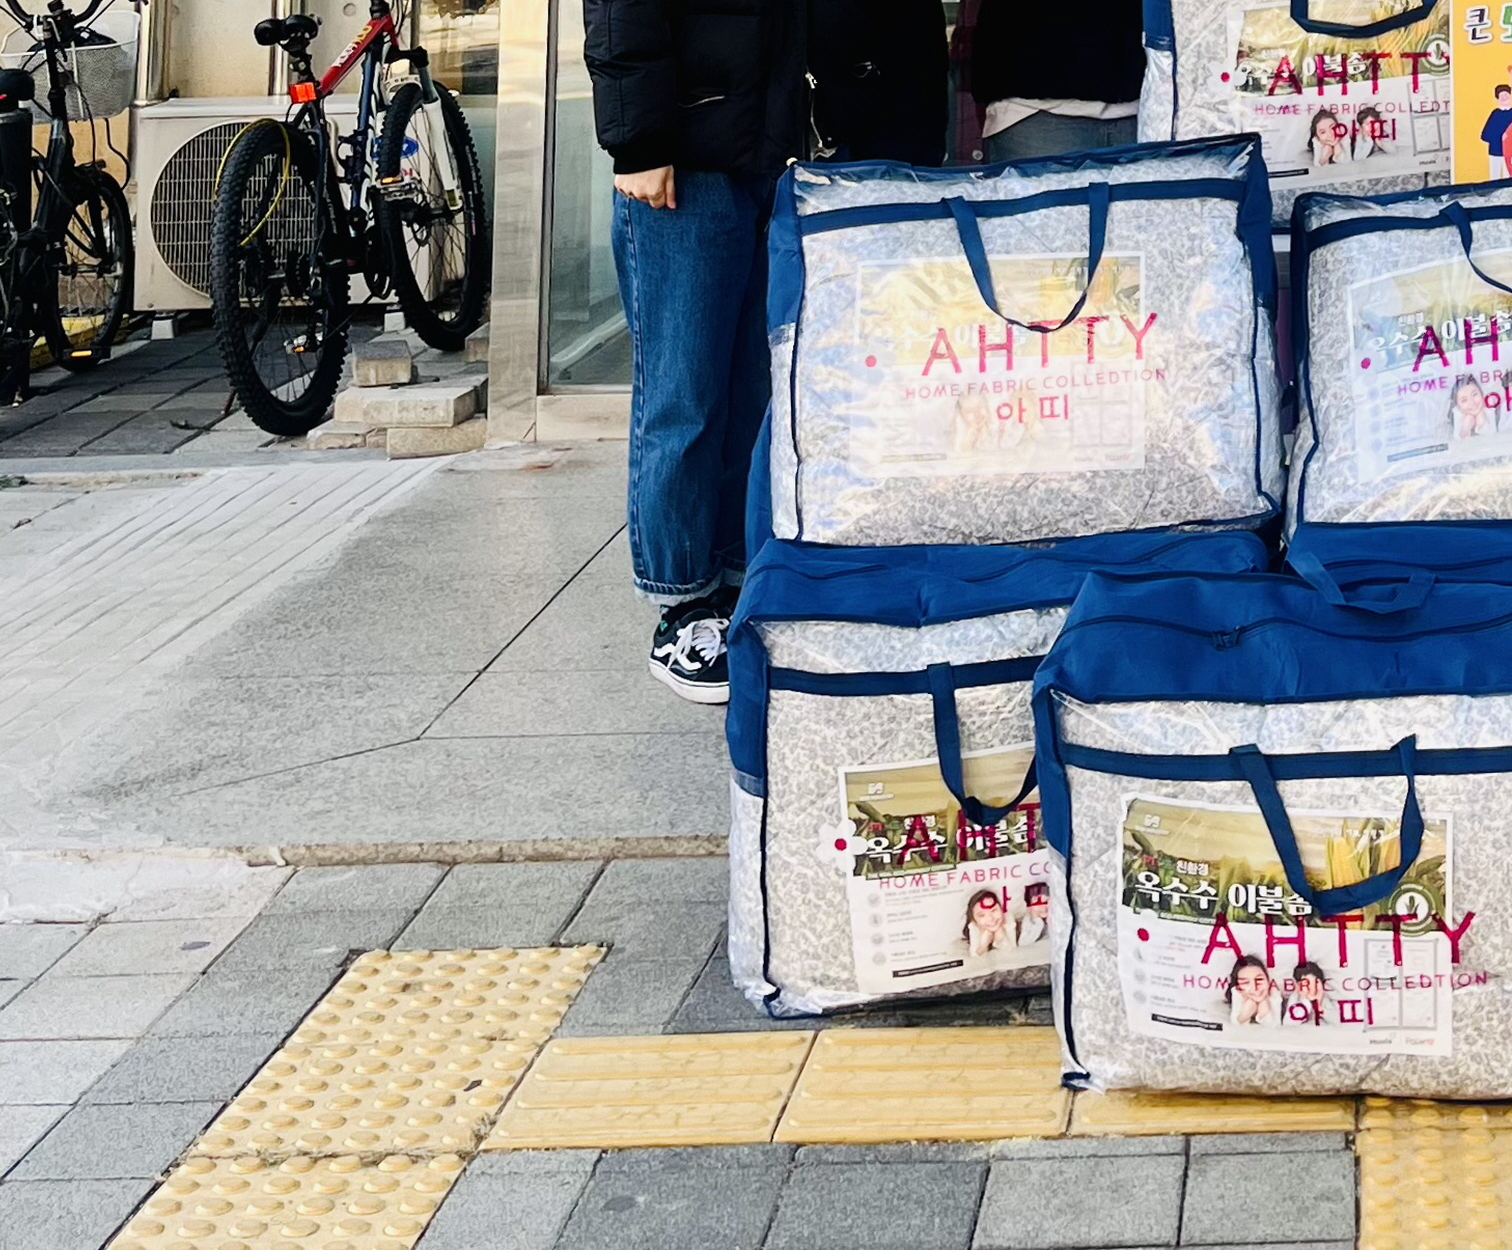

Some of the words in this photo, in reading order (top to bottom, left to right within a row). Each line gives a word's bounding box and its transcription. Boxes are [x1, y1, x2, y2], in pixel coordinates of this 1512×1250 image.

[1465, 7, 1490, 41] 큰
[1268, 51, 1449, 96] AHTT
[1254, 103, 1301, 115] HOME
[1331, 118, 1397, 141] 아띠
[922, 312, 1158, 376] AHTTY
[905, 384, 961, 400] HOME
[967, 377, 1037, 395] FABRIC
[1397, 376, 1449, 395] HOME
[996, 394, 1069, 424] 아띠
[897, 802, 1041, 866] AHT
[879, 872, 942, 890] HOME
[947, 864, 1023, 884] FABRIC
[1134, 870, 1220, 910] 옥수수
[1227, 882, 1313, 916] 이불솜
[1200, 910, 1476, 968] AHTTY
[1182, 973, 1244, 992] HOME
[1254, 976, 1335, 993] FABRIC
[1288, 997, 1374, 1027] 아띠
